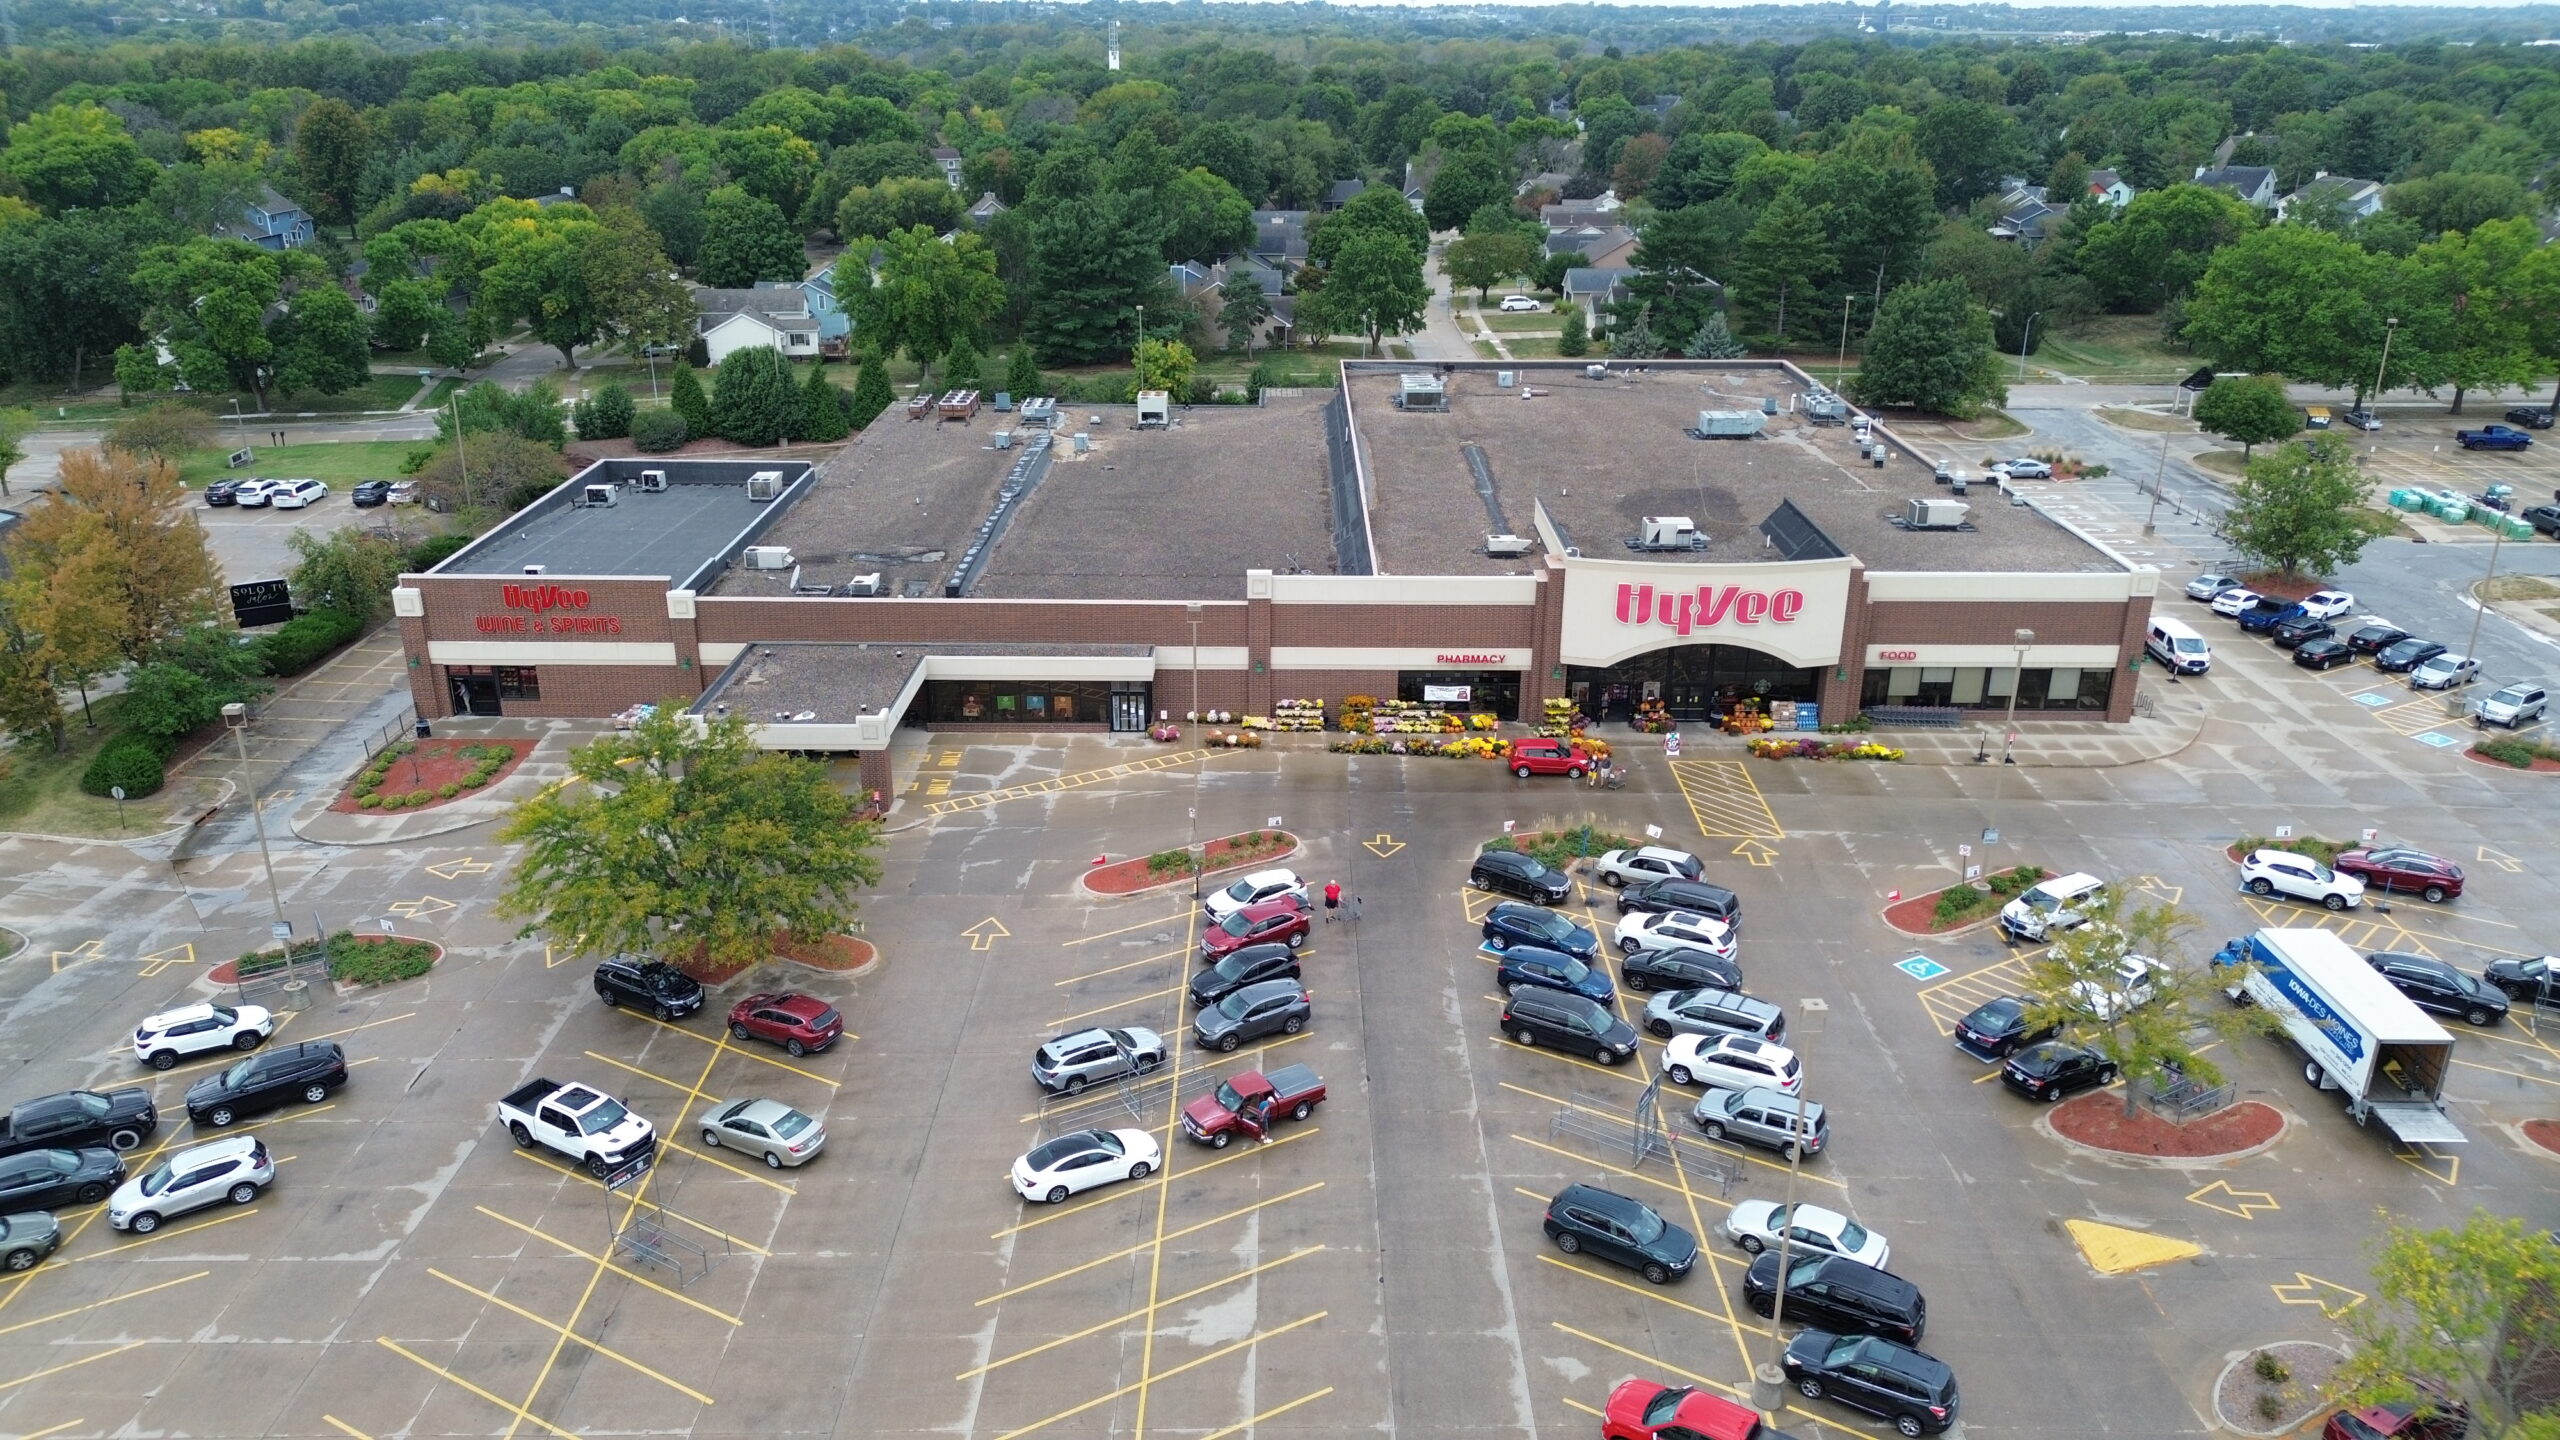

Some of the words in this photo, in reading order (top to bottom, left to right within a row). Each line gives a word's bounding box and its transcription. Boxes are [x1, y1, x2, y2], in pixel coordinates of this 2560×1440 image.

[233, 585, 265, 597] SOLO
[1615, 582, 1804, 636] HyVee
[475, 615, 526, 633] WINE
[533, 620, 544, 633] &
[550, 615, 621, 634] SPIRITS
[1437, 654, 1506, 664] PHARMACY
[1879, 651, 1917, 661] FOOD
[2325, 1014, 2359, 1048] MOINES
